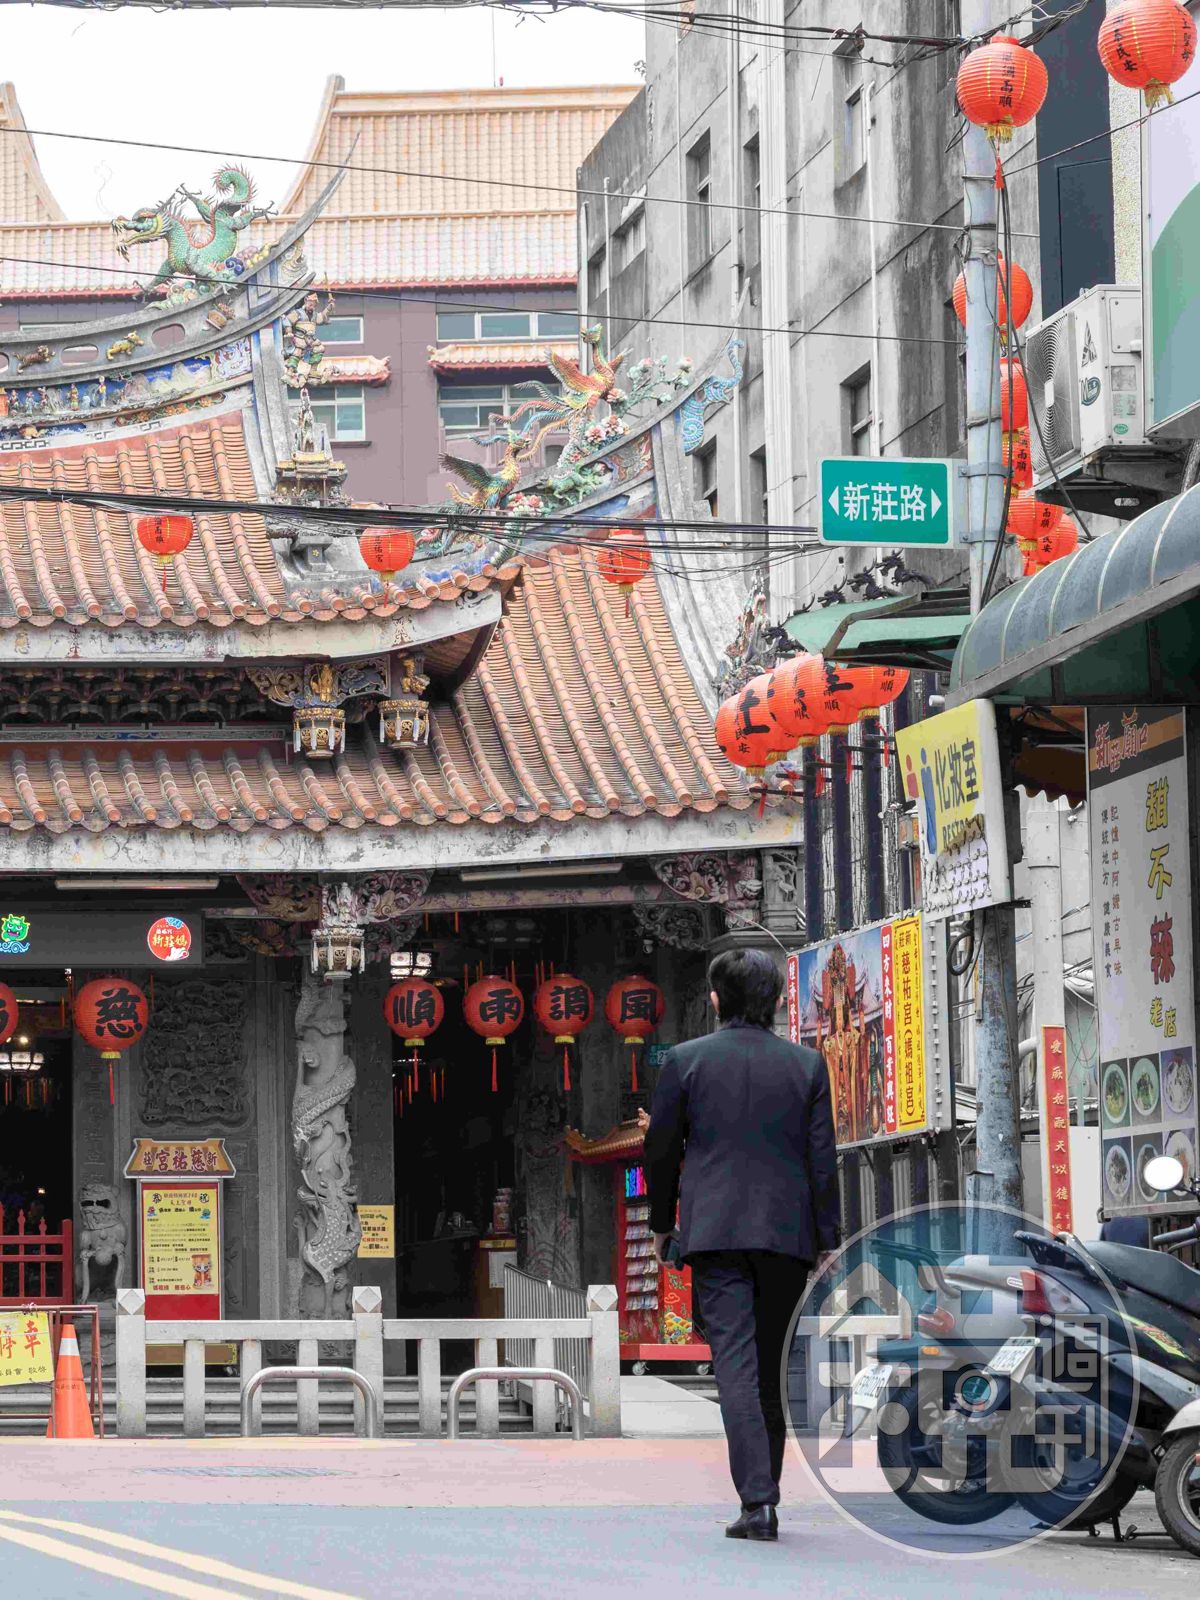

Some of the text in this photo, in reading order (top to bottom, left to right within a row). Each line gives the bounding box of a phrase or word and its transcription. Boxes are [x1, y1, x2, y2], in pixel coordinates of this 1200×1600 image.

[999, 51, 1016, 108] 風調雨順
[843, 481, 927, 521] 新莊路
[95, 989, 143, 1038] 慈
[393, 986, 660, 1028] 風 調 雨 順
